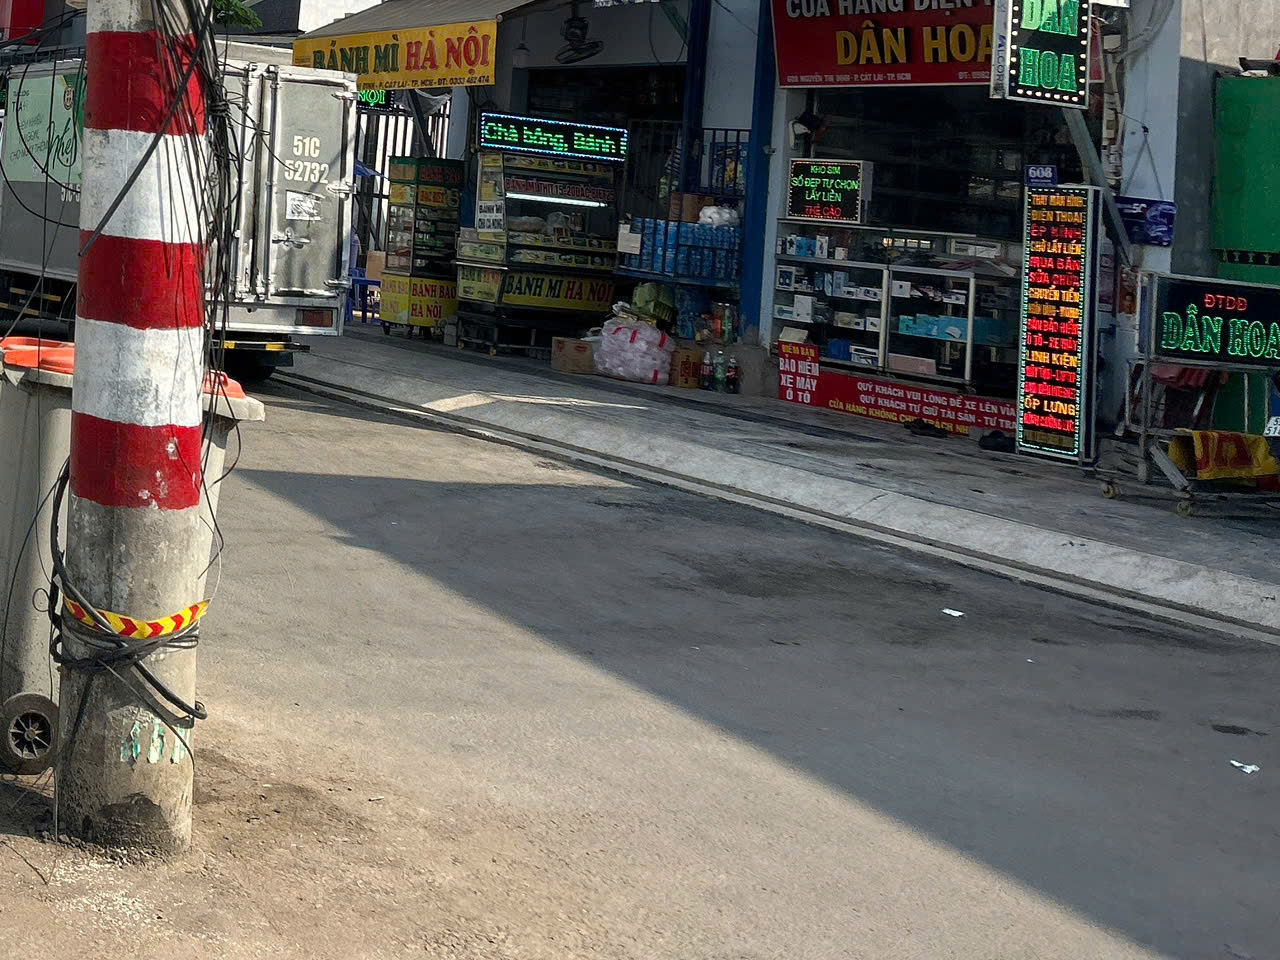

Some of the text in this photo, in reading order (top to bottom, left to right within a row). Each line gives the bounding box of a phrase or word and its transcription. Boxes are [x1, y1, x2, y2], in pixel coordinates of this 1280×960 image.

[312, 25, 491, 76] BÁNH MÌ HÀ NỘI
[836, 19, 994, 65] DÂN HOA
[1018, 47, 1078, 92] HOA
[292, 135, 320, 158] 51C
[284, 160, 329, 184] 52732
[810, 165, 841, 175] KHO SIM
[1028, 166, 1053, 178] 608
[791, 174, 804, 187] SỐ
[822, 178, 834, 189] TỰ
[834, 178, 859, 191] CHỌN
[805, 187, 822, 201] LẤY
[1029, 256, 1054, 269] MUA
[1161, 303, 1280, 360] DÂN HOA
[779, 354, 820, 376] BẢO HIỂM
[1026, 349, 1078, 368] LINH KIỆN
[780, 373, 818, 392] XE MÁY
[786, 387, 811, 404] Ô TÔ
[857, 381, 873, 392] QUÝ
[875, 383, 904, 398] KHÁCH
[906, 389, 921, 401] VUI
[923, 391, 948, 406] LÒNG
[964, 400, 977, 411] XE
[979, 401, 998, 414] LÊN
[1024, 393, 1076, 416] ỐP LƯNG
[828, 397, 843, 410] CỬA
[845, 401, 867, 416] HÀNG
[868, 406, 898, 421] KHÔNG
[877, 395, 907, 411] KHÁCH
[940, 407, 956, 420] TÀI
